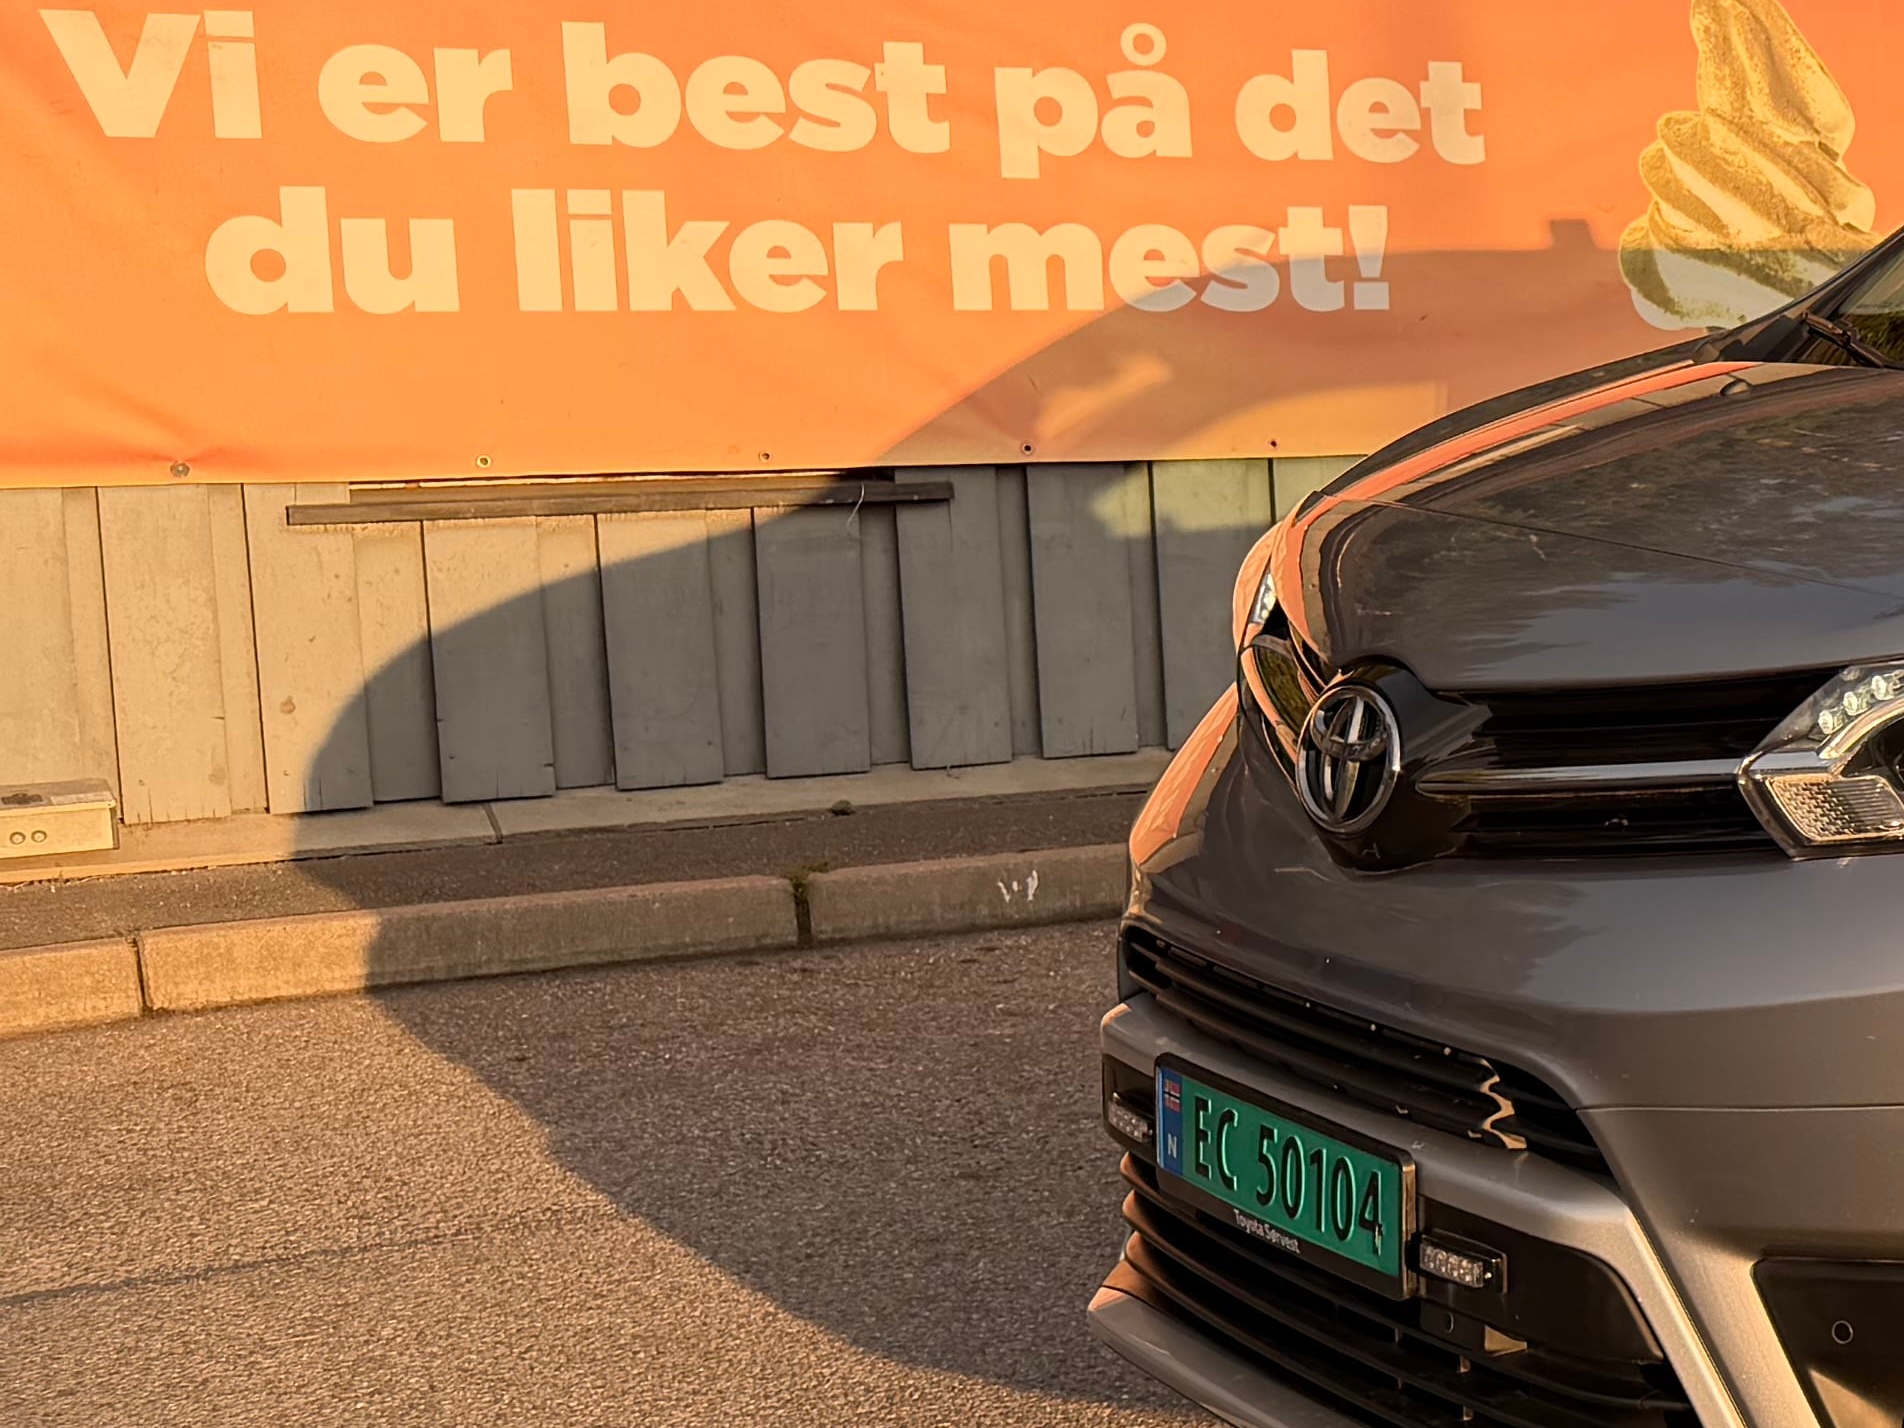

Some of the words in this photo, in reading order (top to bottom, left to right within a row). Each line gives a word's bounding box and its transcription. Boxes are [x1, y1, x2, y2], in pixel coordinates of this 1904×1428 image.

[40, 9, 262, 140] Vi
[318, 39, 513, 144] er
[560, 21, 952, 154] best
[994, 22, 1192, 179] på
[1234, 48, 1486, 167] det
[204, 185, 461, 316] du
[511, 187, 904, 314] liker
[948, 203, 1391, 314] mest!
[1167, 1133, 1178, 1159] N
[1194, 1094, 1239, 1192] EC
[1255, 1123, 1384, 1258] 50104
[1232, 1207, 1265, 1237] Toyota
